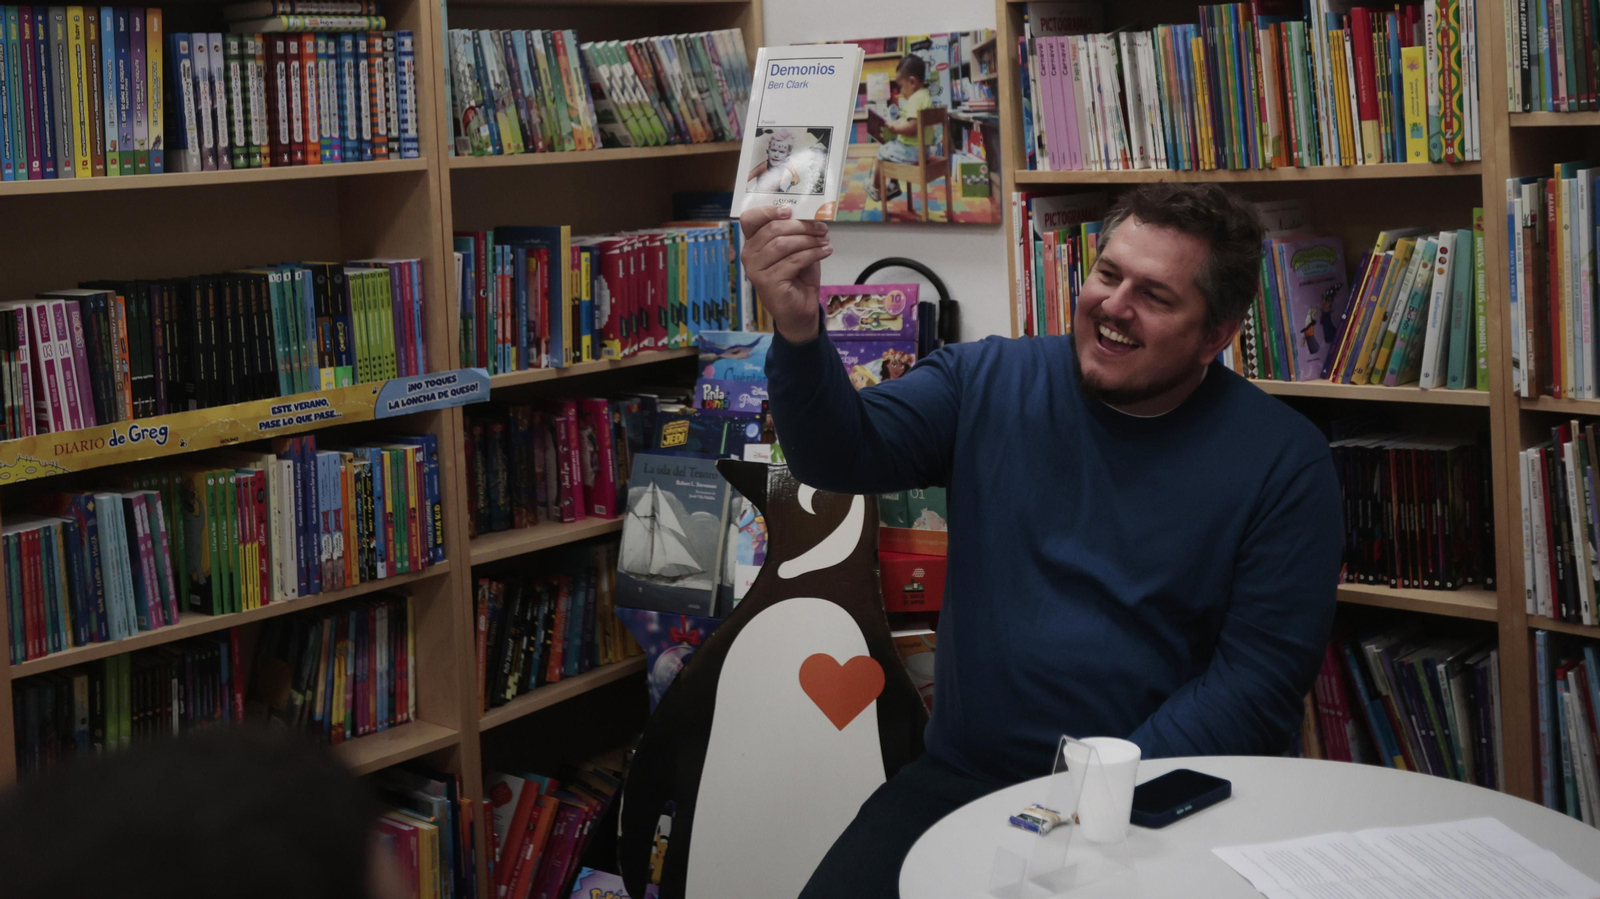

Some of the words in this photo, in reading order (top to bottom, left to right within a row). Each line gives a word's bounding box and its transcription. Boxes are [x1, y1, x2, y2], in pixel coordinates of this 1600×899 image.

[1038, 43, 1046, 76] Carnaval
[1048, 43, 1057, 76] Carnaval
[1060, 42, 1068, 76] Carnaval
[770, 63, 835, 76] Demonios
[767, 80, 785, 90] Ben
[786, 80, 809, 89] Clark
[1476, 236, 1484, 267] NUEVAS
[891, 294, 902, 304] 10
[1478, 315, 1487, 353] ANIMALES
[42, 344, 53, 359] 03
[58, 342, 70, 357] 04
[407, 381, 423, 392] ¡NO
[424, 375, 457, 390] TOQUES
[702, 384, 725, 400] Pinta
[388, 400, 400, 410] LA
[400, 392, 436, 407] LONCHA
[437, 390, 449, 400] DE
[450, 383, 479, 398] QUESO!
[271, 404, 292, 416] ESTE
[293, 398, 330, 411] VERANO,
[258, 419, 280, 430] PASE
[282, 417, 294, 427] LO
[295, 414, 313, 426] QUE
[54, 438, 106, 456] DIARIO
[108, 428, 126, 447] de
[128, 425, 168, 446] Greg
[663, 432, 686, 446] JEDI
[643, 462, 655, 474] La
[656, 464, 671, 476] isla
[672, 465, 686, 477] del
[686, 466, 718, 480] Tesoro
[435, 520, 443, 545] NINJA
